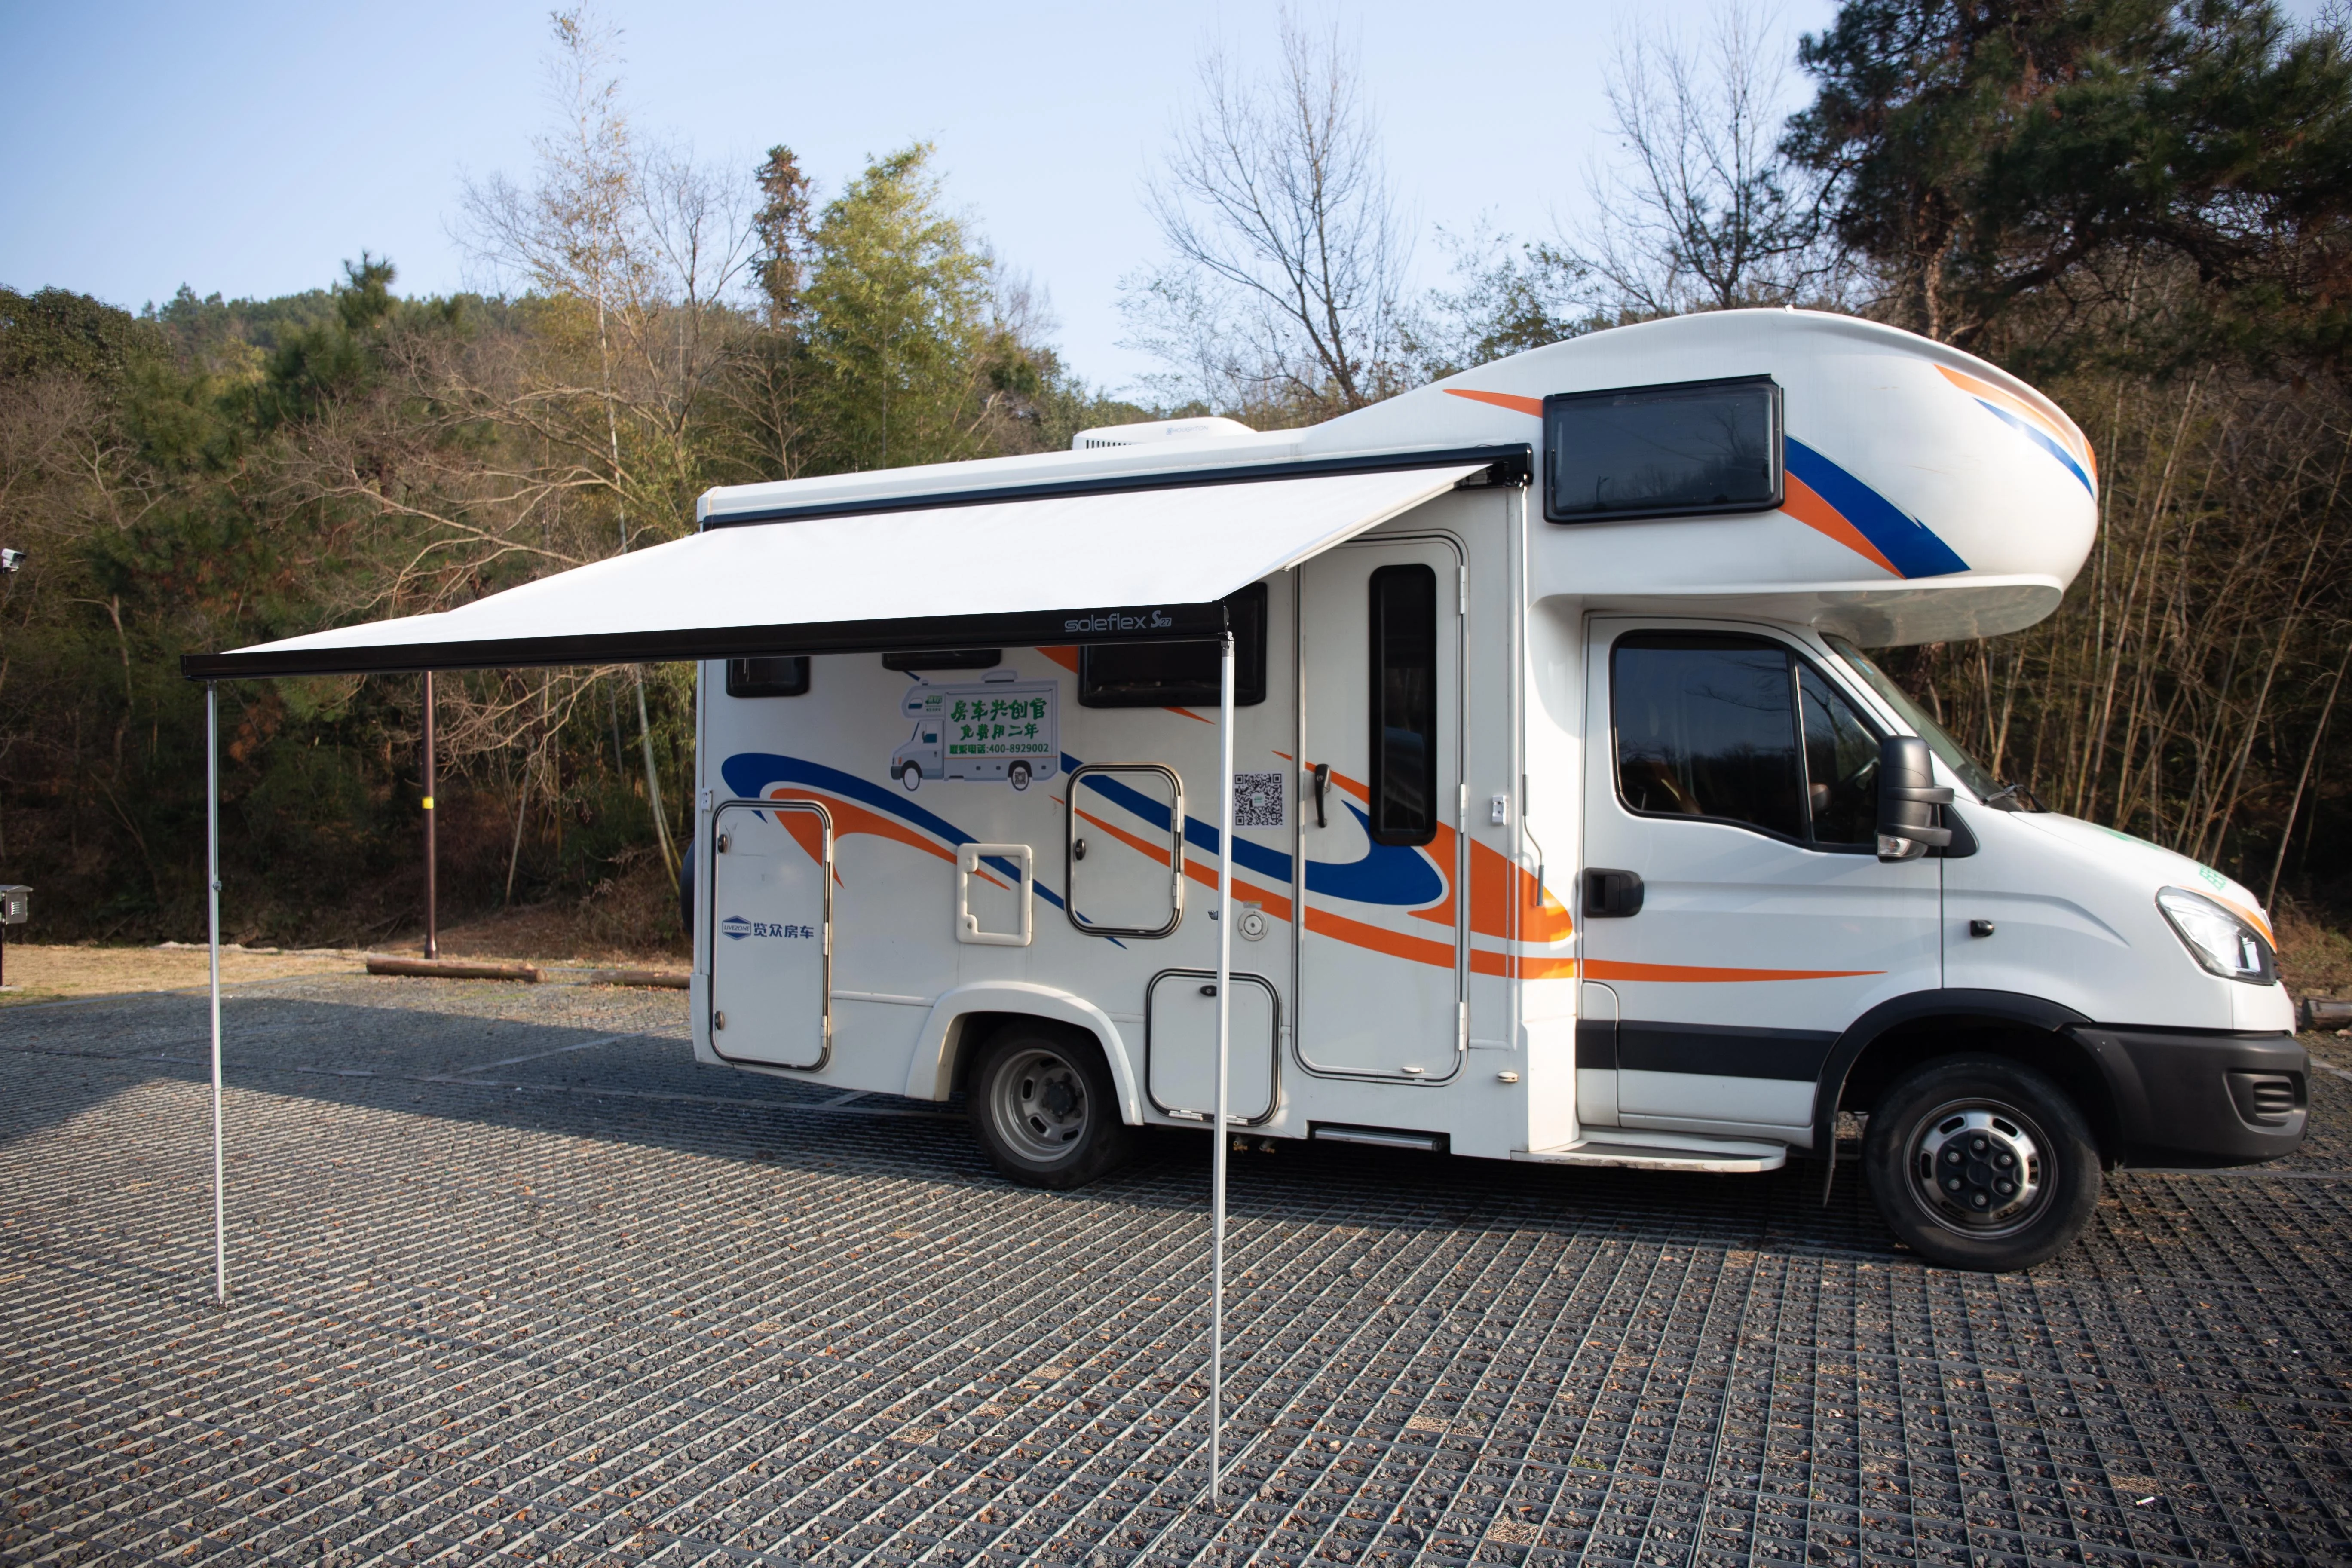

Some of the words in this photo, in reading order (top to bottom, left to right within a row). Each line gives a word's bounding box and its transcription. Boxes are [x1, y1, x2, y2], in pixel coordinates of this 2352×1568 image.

[1064, 613, 1147, 632] soleflex
[951, 698, 1047, 722] 房车共创官
[960, 722, 1039, 741] 免费用二年
[754, 922, 814, 939] 览众房车
